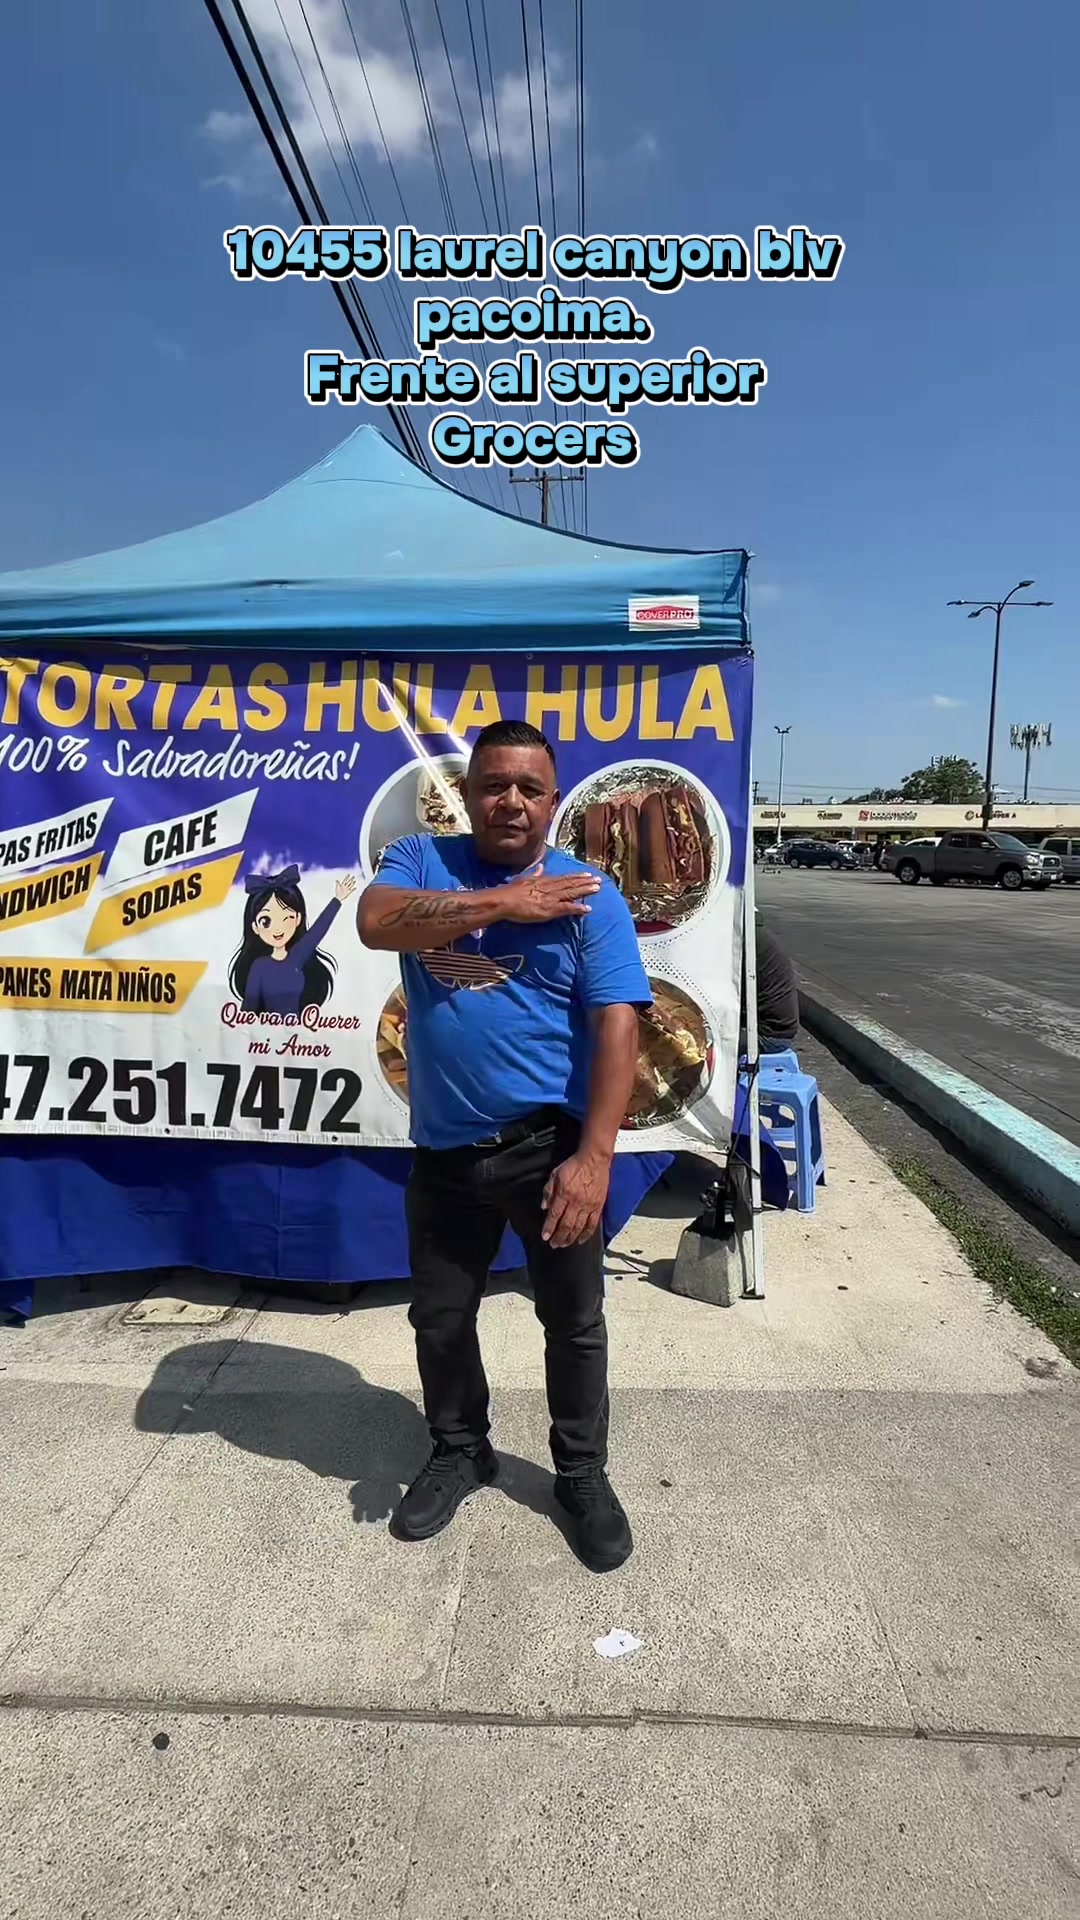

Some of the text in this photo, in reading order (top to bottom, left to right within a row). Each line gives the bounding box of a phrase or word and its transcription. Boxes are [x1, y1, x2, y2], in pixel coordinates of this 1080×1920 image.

[637, 608, 692, 620] COVERPRO
[0, 657, 735, 742] TORTAS HULA HULA
[0, 732, 361, 781] 100% Salvadoreñas!
[35, 811, 98, 858] FRITAS
[144, 809, 218, 867] CAFE
[122, 872, 202, 926] SODAS
[60, 969, 113, 1001] MATA
[117, 966, 177, 1004] NIÑOS
[221, 1001, 362, 1032] Que va a Querer
[248, 1033, 332, 1057] mi Amor
[0, 1053, 363, 1133] 7.251.7472
